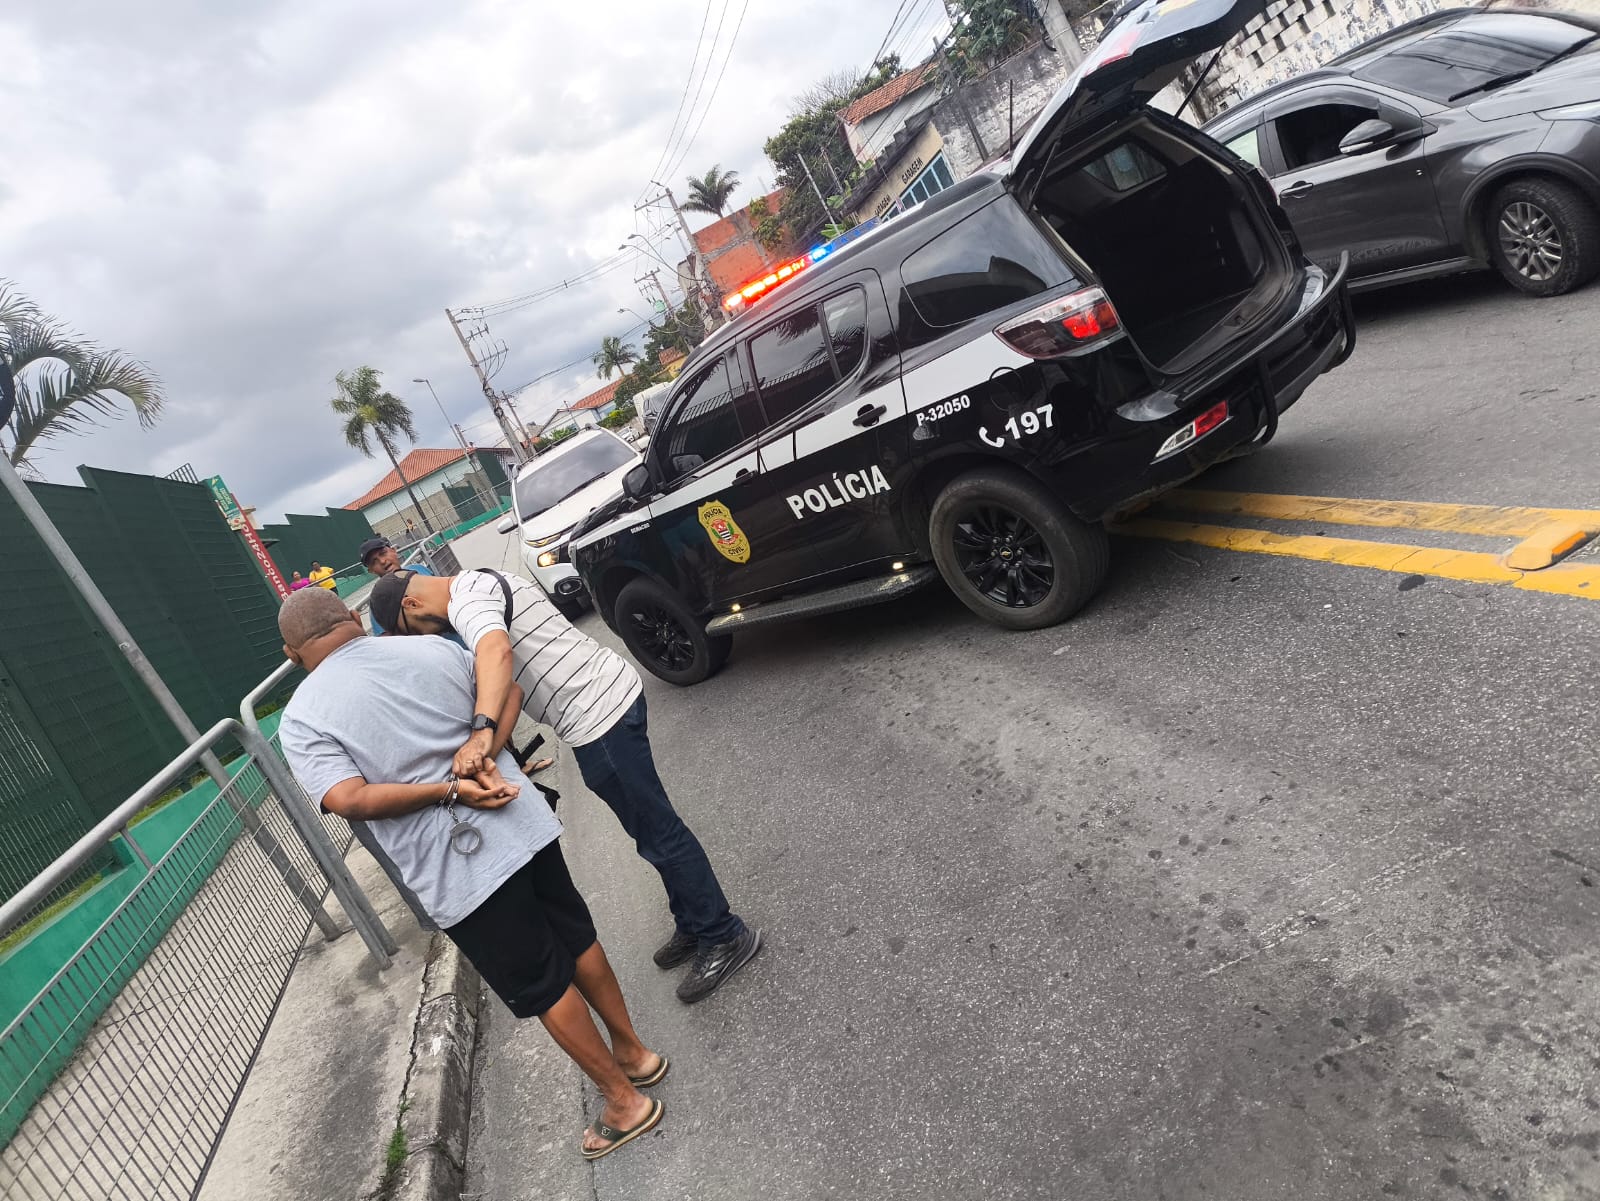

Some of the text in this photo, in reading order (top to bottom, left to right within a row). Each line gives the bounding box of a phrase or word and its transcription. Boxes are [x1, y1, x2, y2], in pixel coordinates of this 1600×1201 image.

[901, 157, 923, 184] GARAGEM
[916, 394, 971, 427] P-32050
[1004, 403, 1054, 440] 197
[786, 465, 892, 520] POLÍCIA
[241, 523, 289, 602] Banco24Ho
[727, 546, 745, 556] CIVIL
